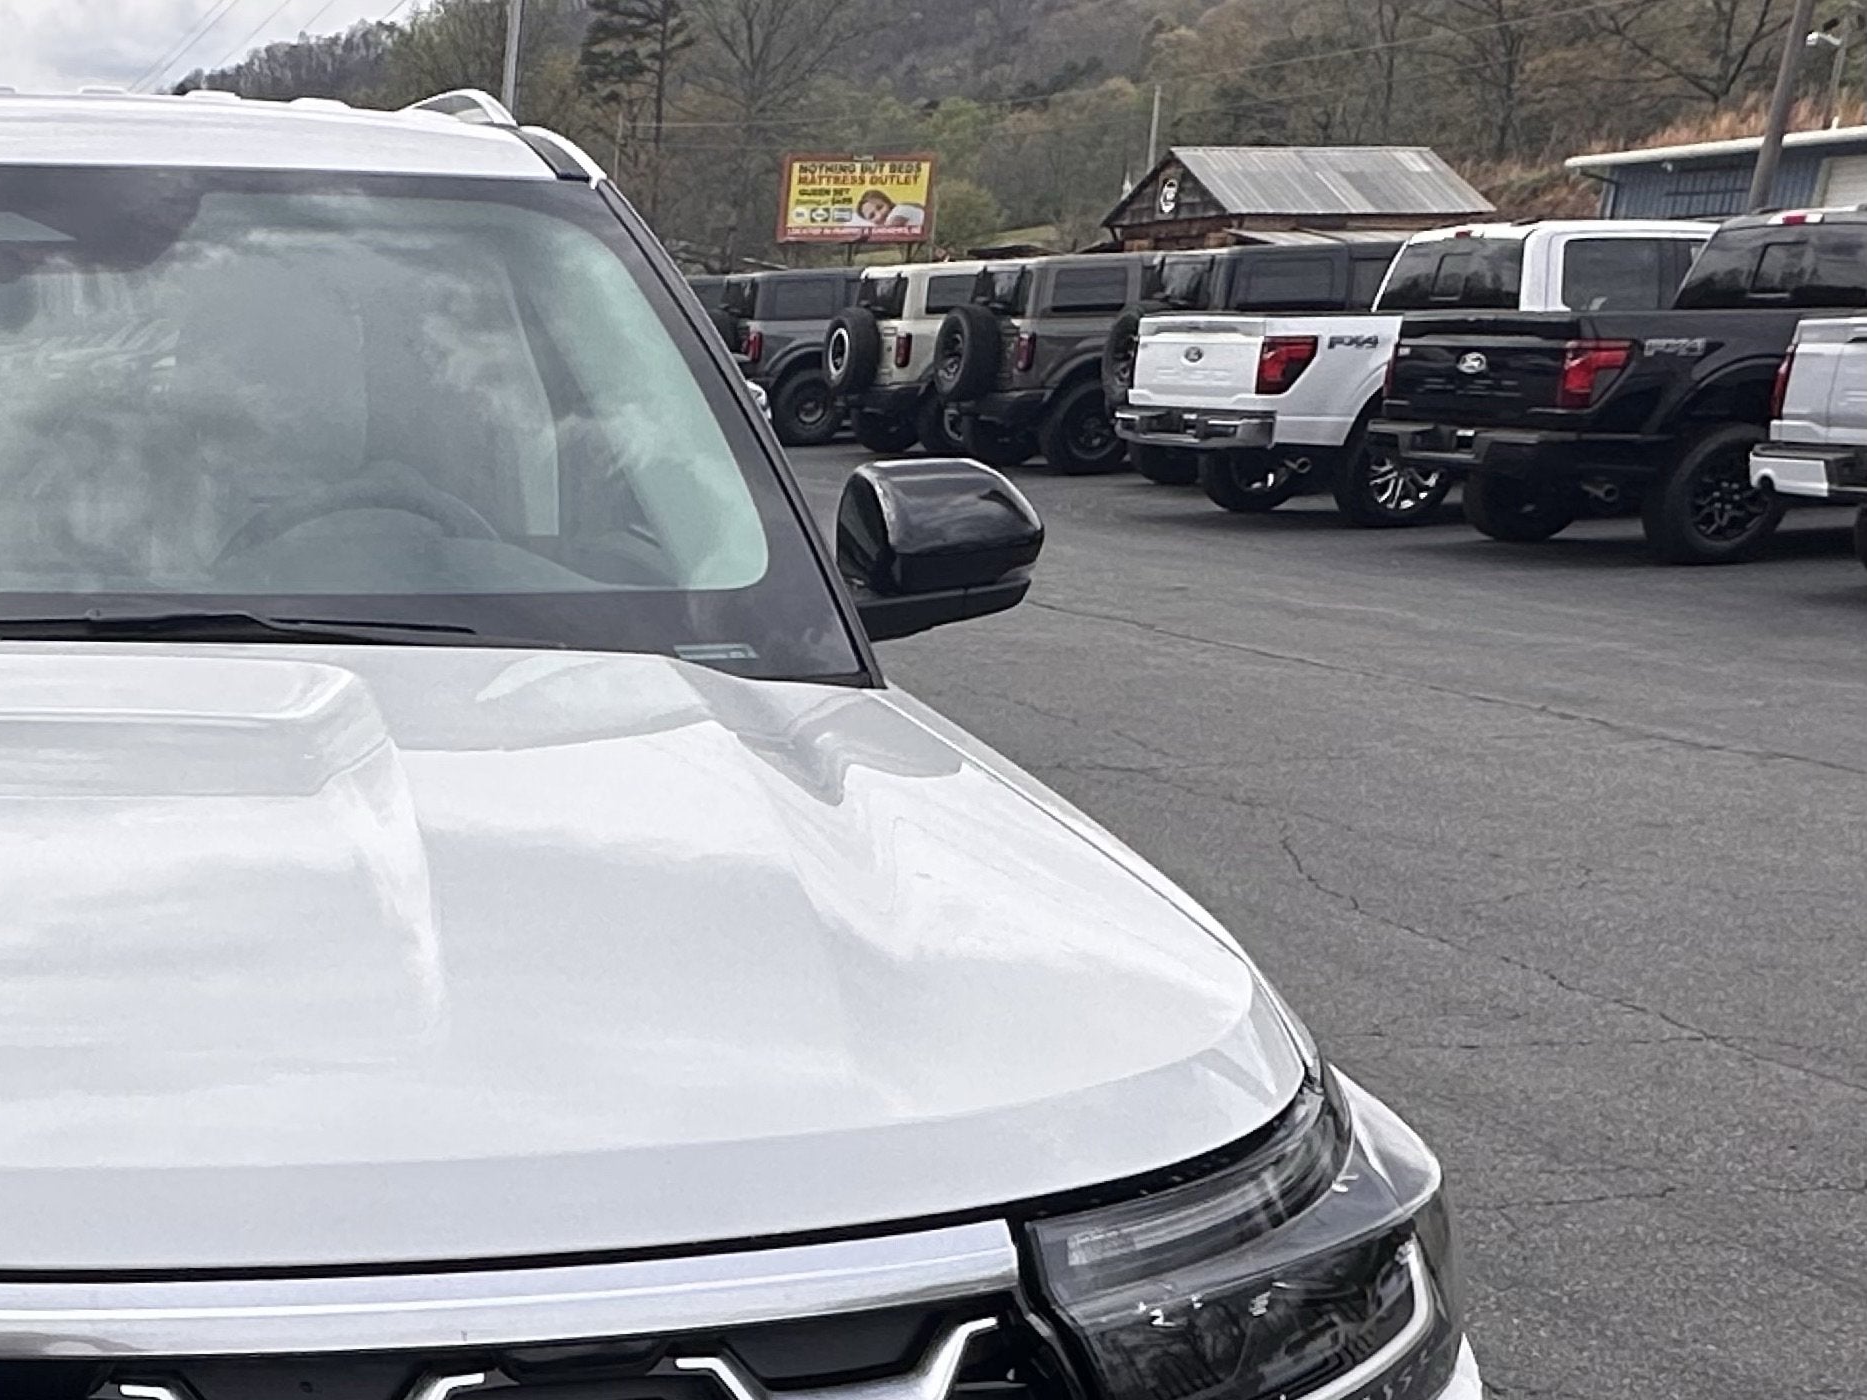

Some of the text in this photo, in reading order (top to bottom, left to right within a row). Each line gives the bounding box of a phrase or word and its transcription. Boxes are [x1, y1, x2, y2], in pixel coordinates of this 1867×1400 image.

[799, 163, 922, 174] NOTHING BUT BEDS
[797, 174, 920, 186] MATTRESS OUTLET
[1328, 335, 1379, 349] FX4
